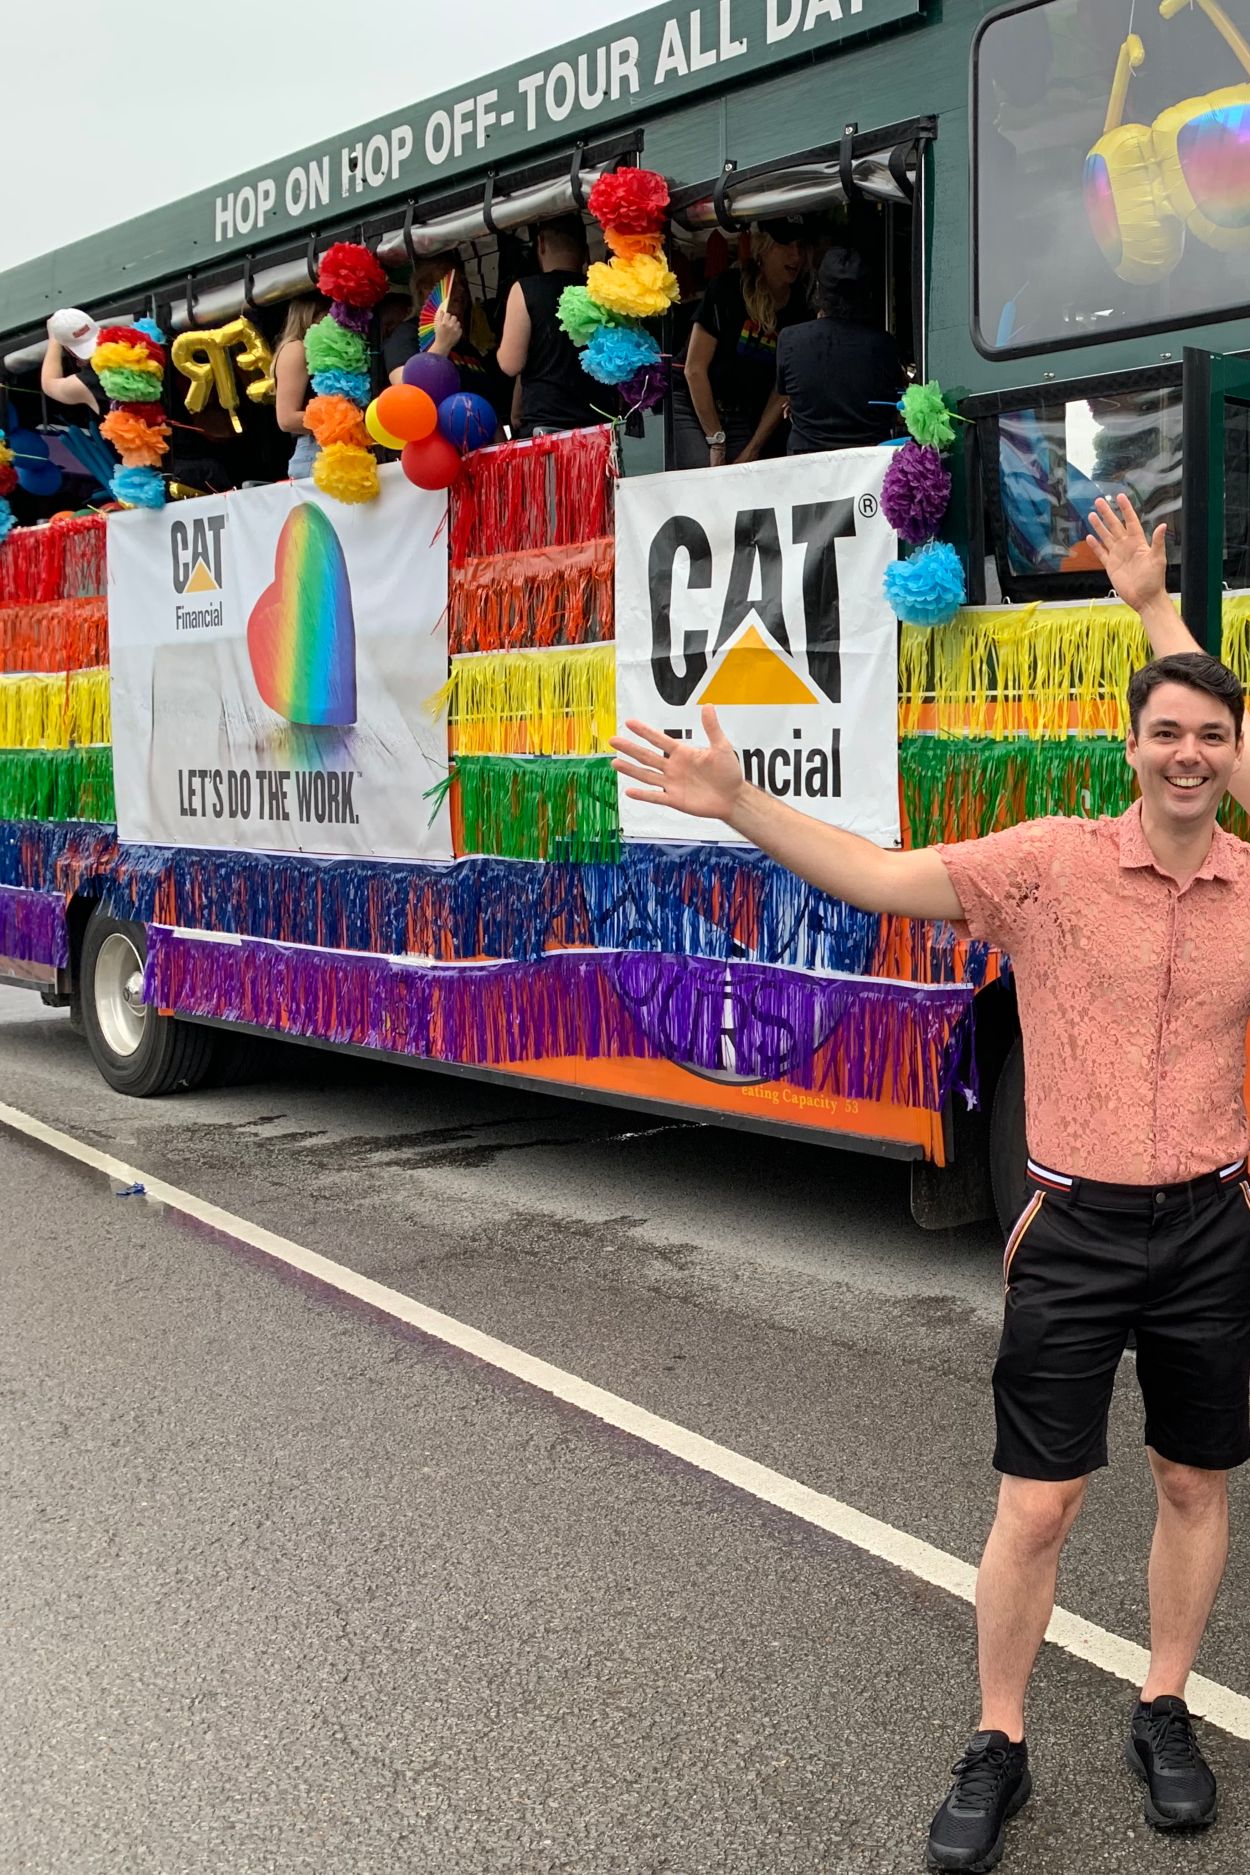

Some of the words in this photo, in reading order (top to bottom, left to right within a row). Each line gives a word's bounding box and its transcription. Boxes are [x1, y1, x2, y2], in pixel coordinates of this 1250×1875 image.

[215, 179, 276, 242] HOP
[285, 155, 330, 217] ON
[341, 124, 413, 198] HOP
[654, 0, 747, 85] ALL
[171, 514, 225, 594] CAT
[176, 601, 223, 630] Financial
[178, 769, 224, 819] LET'S
[228, 769, 250, 820] DO
[256, 770, 290, 821] THE
[295, 770, 359, 825] WORK.
[782, 1088, 838, 1115] Capacity
[845, 1100, 859, 1114] 53
